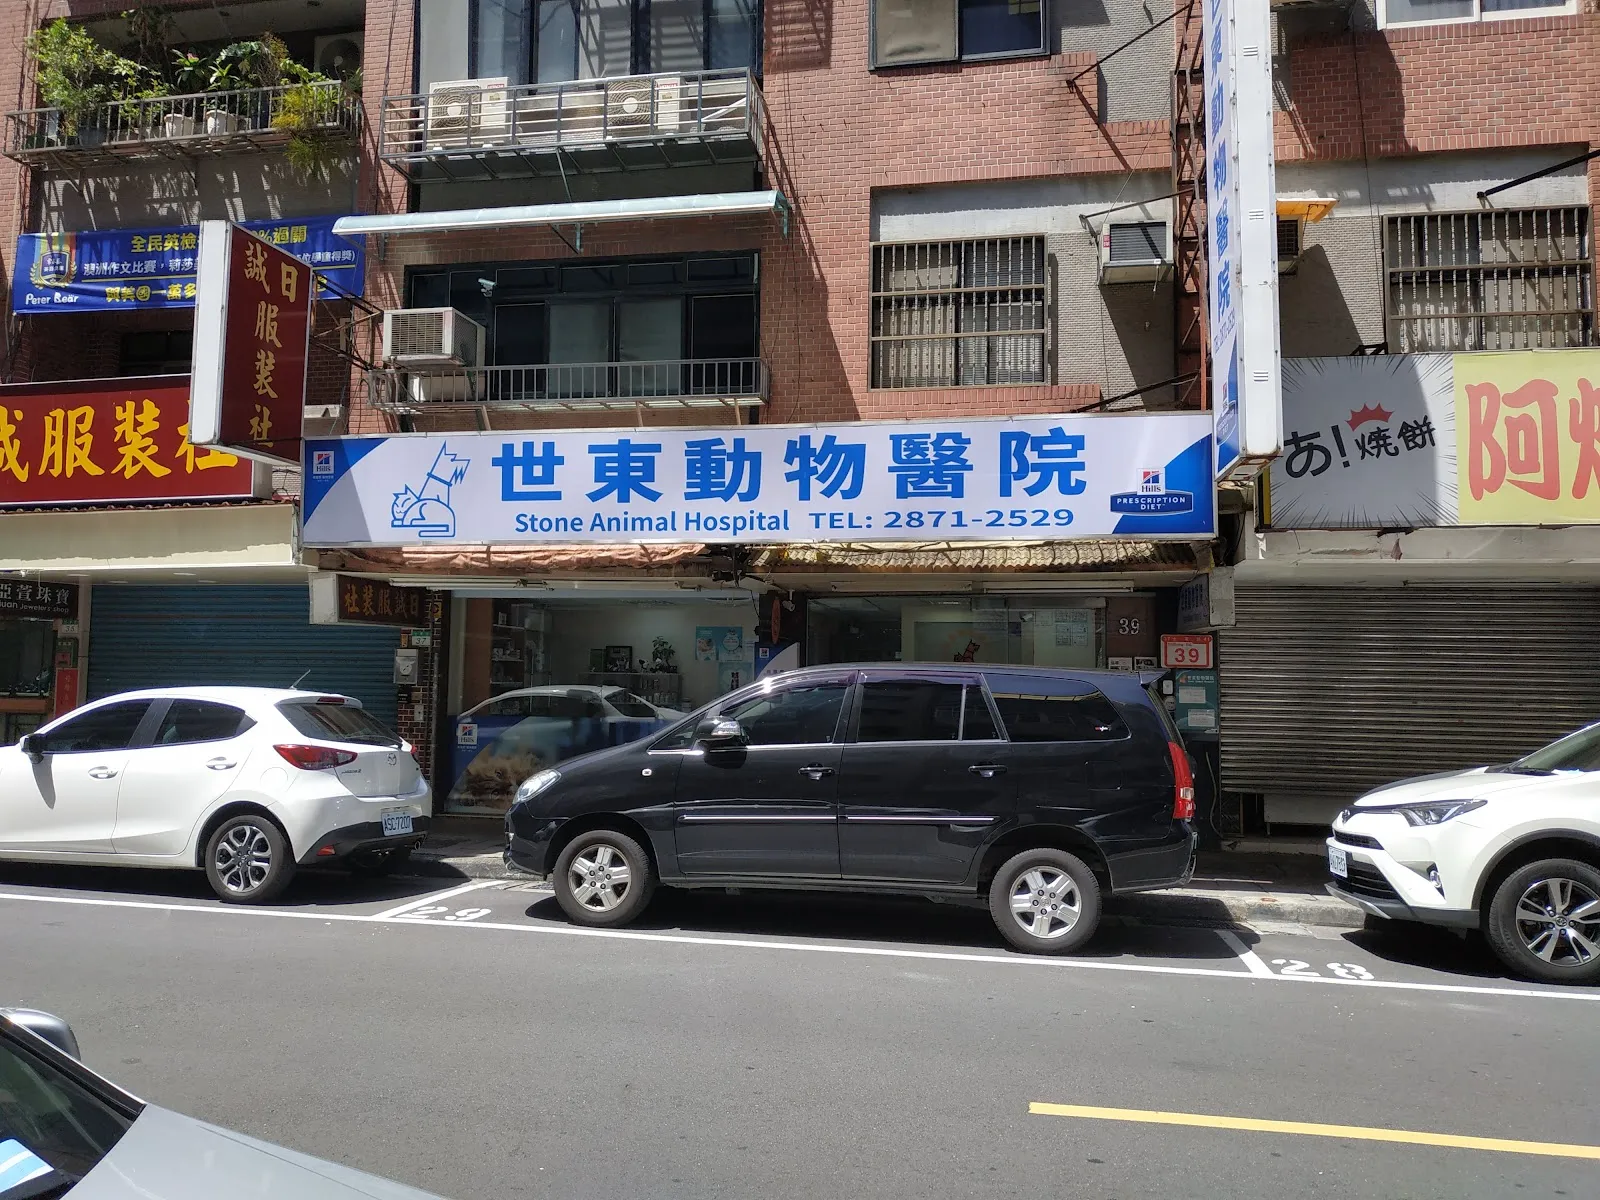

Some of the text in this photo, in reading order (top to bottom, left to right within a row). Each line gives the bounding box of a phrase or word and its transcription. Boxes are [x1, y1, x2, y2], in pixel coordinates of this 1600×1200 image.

[25, 293, 51, 305] Peter
[491, 426, 1087, 503] 世東動物醫院
[1116, 496, 1186, 505] PRESCRIPTION
[515, 508, 1074, 537] Stone Animal Hospital TEL: 2871-2529
[0, 600, 18, 609] uan
[1118, 617, 1140, 635] 39
[1174, 647, 1200, 663] 39
[1271, 958, 1375, 980] 28
